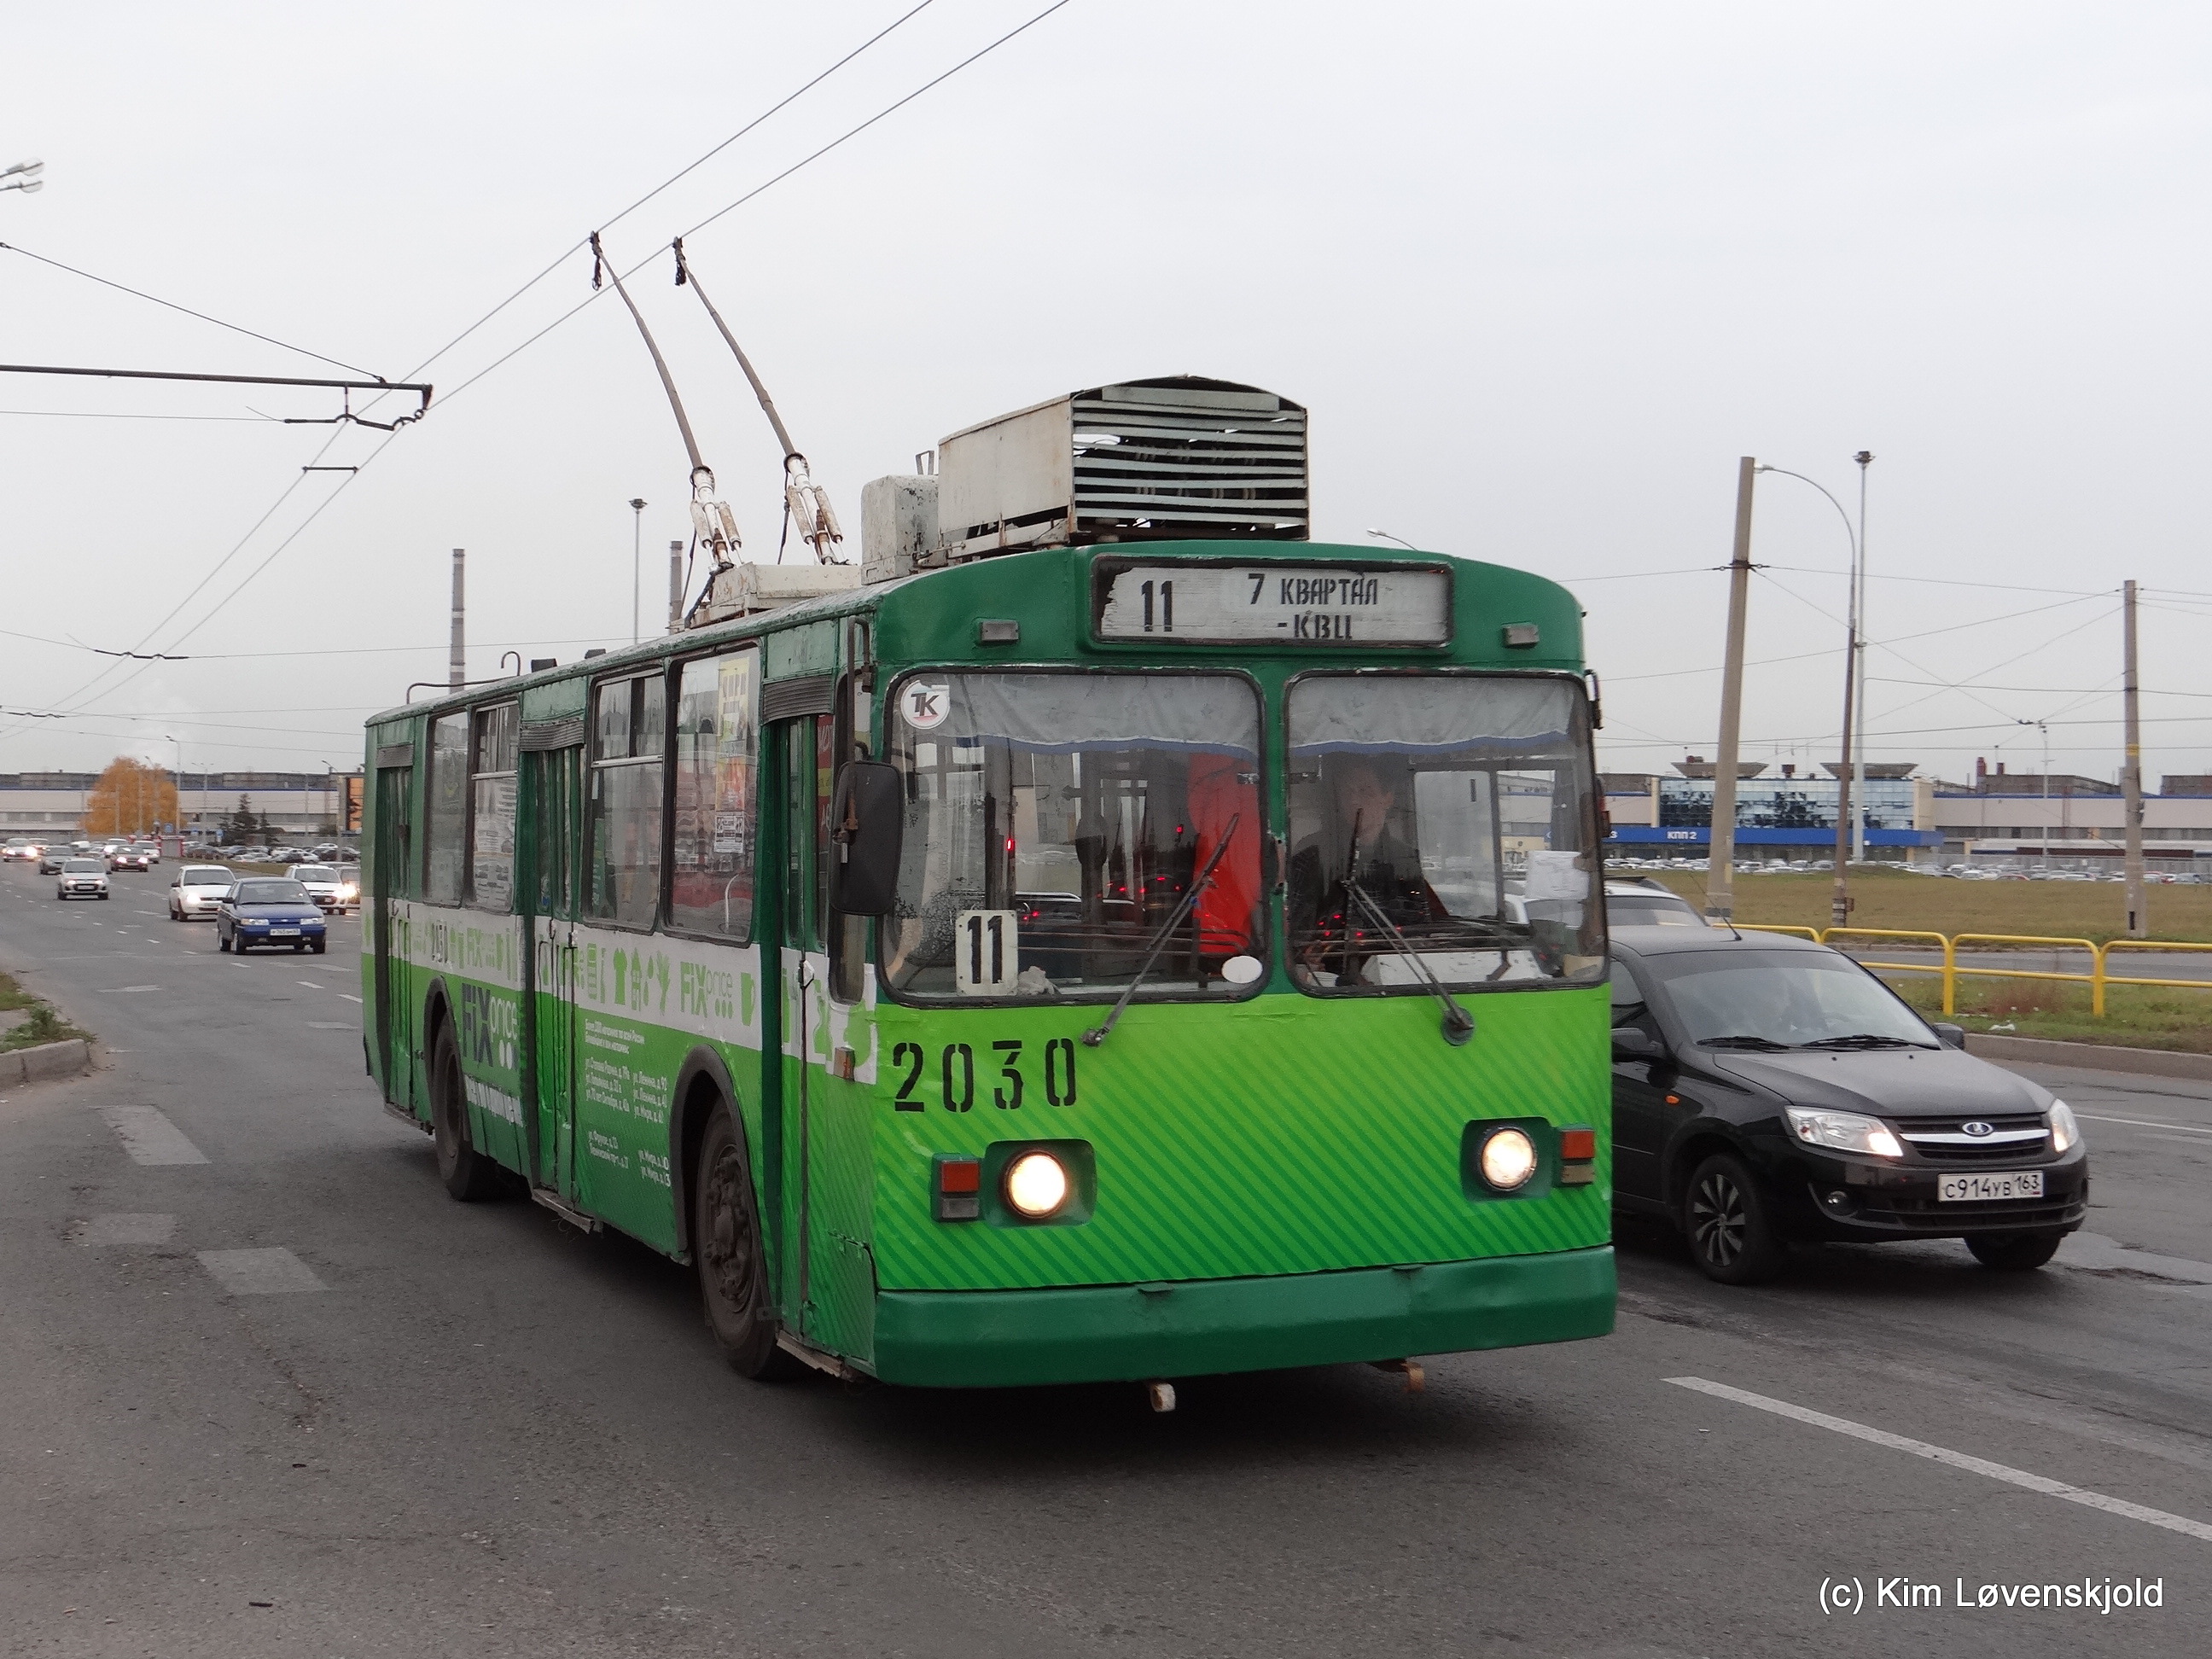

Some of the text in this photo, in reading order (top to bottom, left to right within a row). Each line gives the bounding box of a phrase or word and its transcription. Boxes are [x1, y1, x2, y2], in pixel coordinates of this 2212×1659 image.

[1141, 579, 1173, 632] 11
[1247, 573, 1379, 606] 7 КВАРТАЛ
[1666, 830, 1697, 840] КПП 2
[966, 915, 1004, 985] 11
[892, 1038, 1078, 1113] 2030
